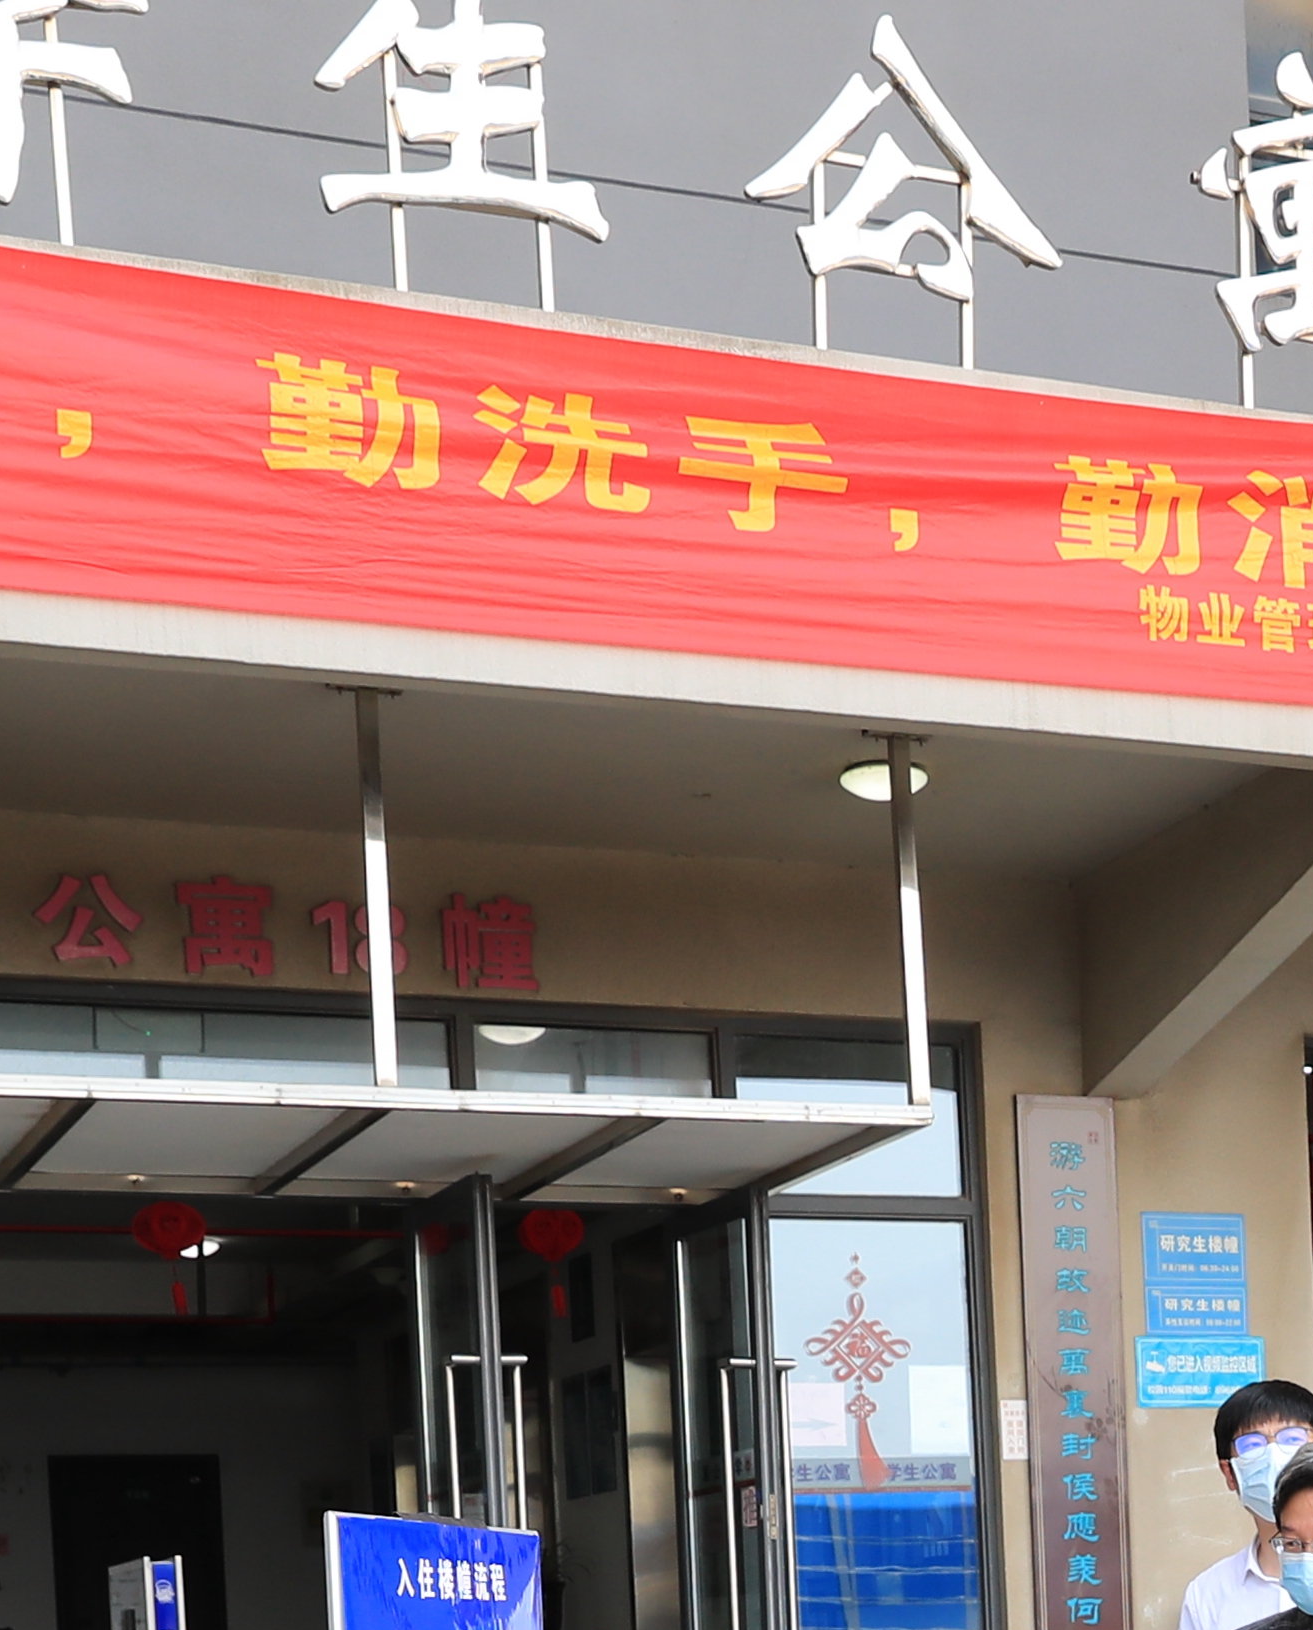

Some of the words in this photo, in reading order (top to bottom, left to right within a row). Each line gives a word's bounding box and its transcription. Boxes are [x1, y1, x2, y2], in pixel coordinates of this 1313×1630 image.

[1160, 1234, 1240, 1255] 研究生楼幢
[1164, 1298, 1241, 1312] 研究生楼幢
[791, 1463, 851, 1482] 生公寓
[396, 1557, 507, 1602] 入住楼幢流程
